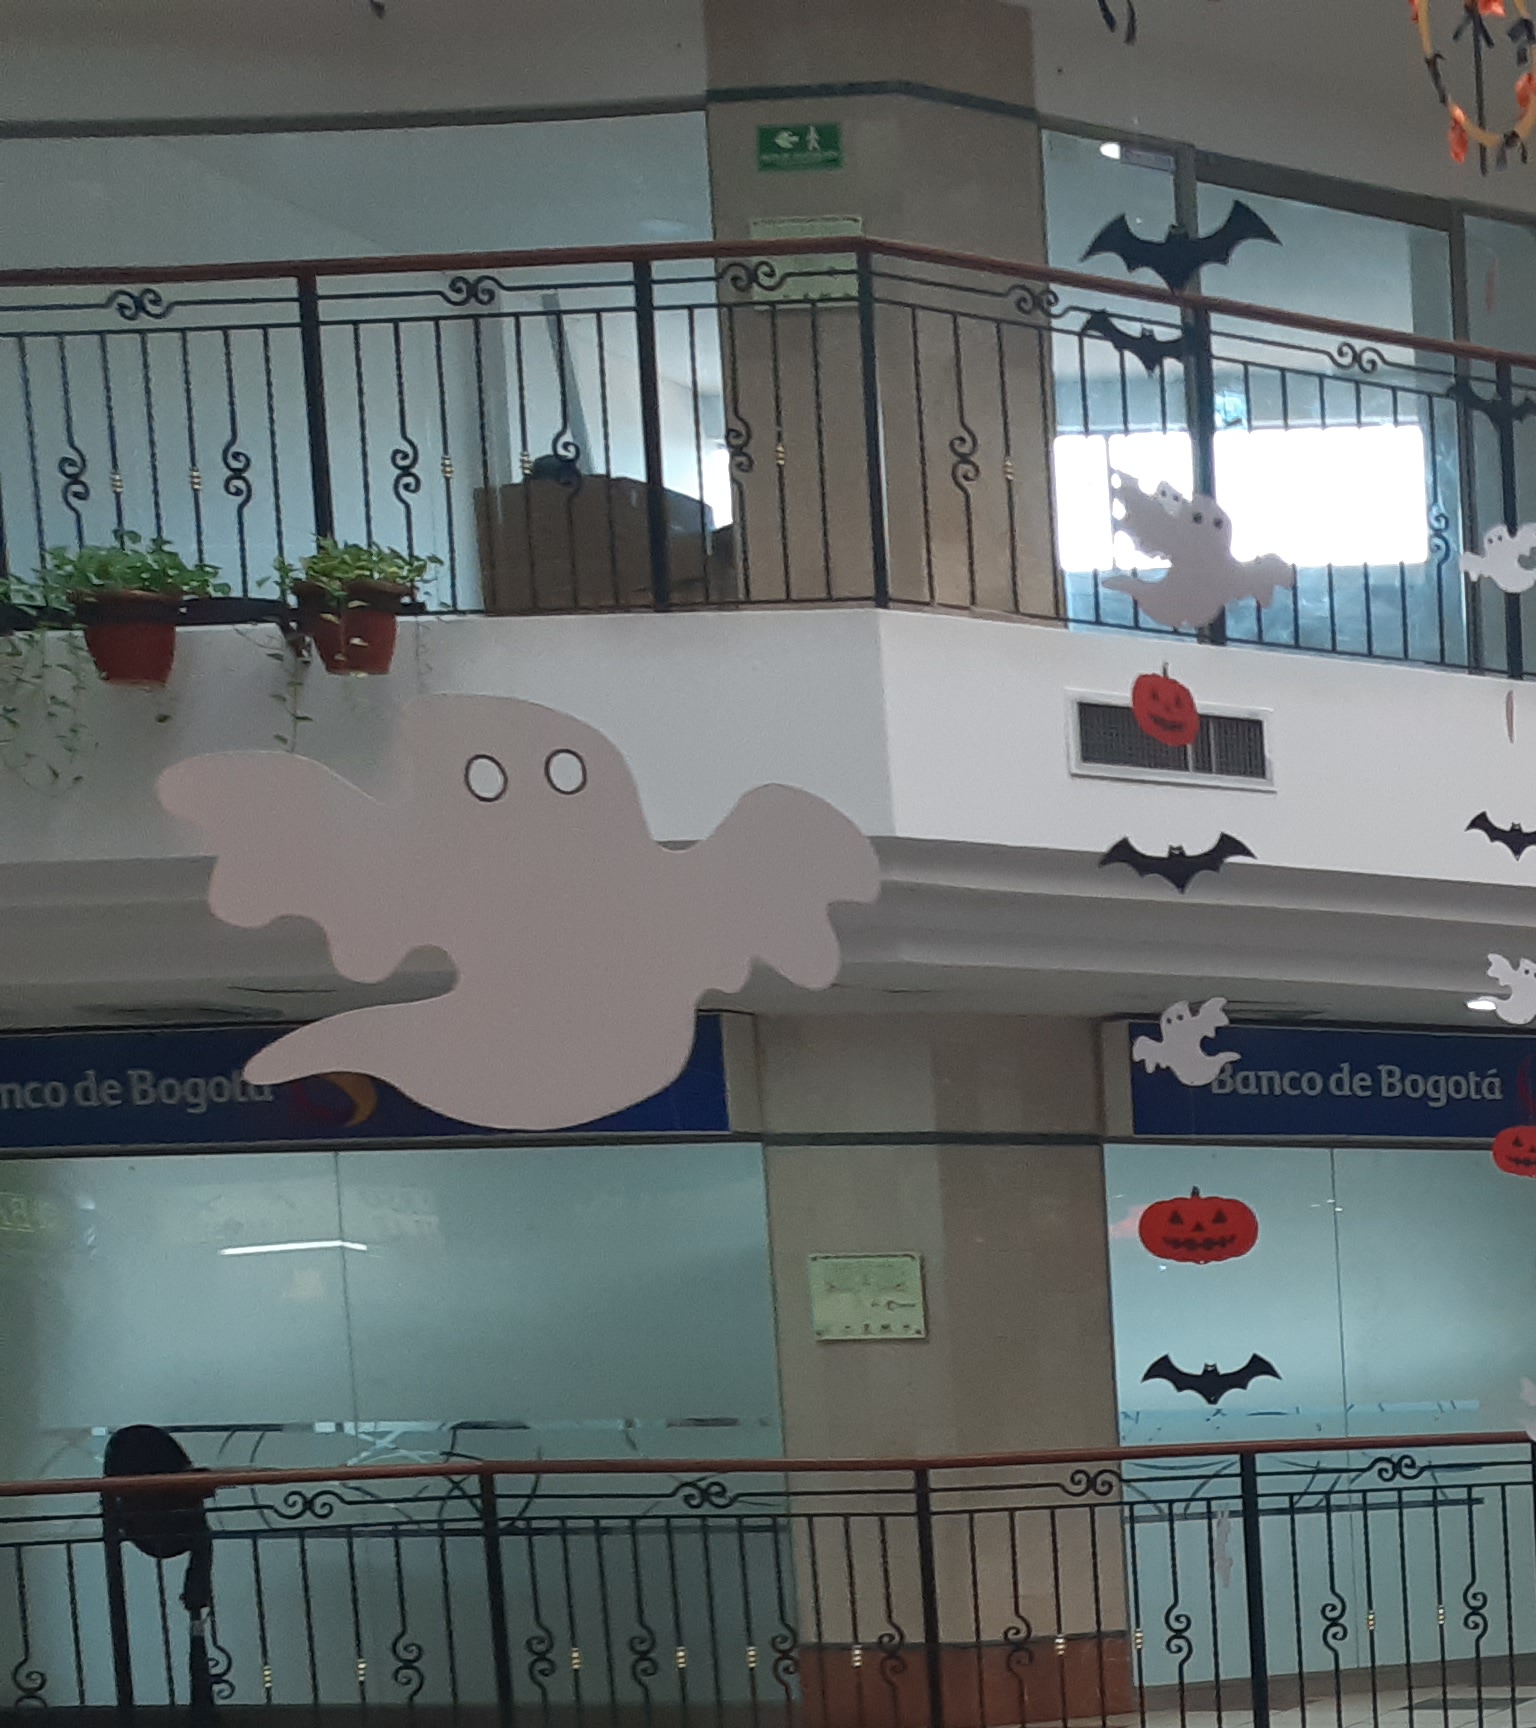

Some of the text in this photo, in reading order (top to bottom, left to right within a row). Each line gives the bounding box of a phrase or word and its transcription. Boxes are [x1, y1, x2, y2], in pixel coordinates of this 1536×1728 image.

[74, 1069, 123, 1107] de
[1211, 1062, 1503, 1108] Banco de Bogotá
